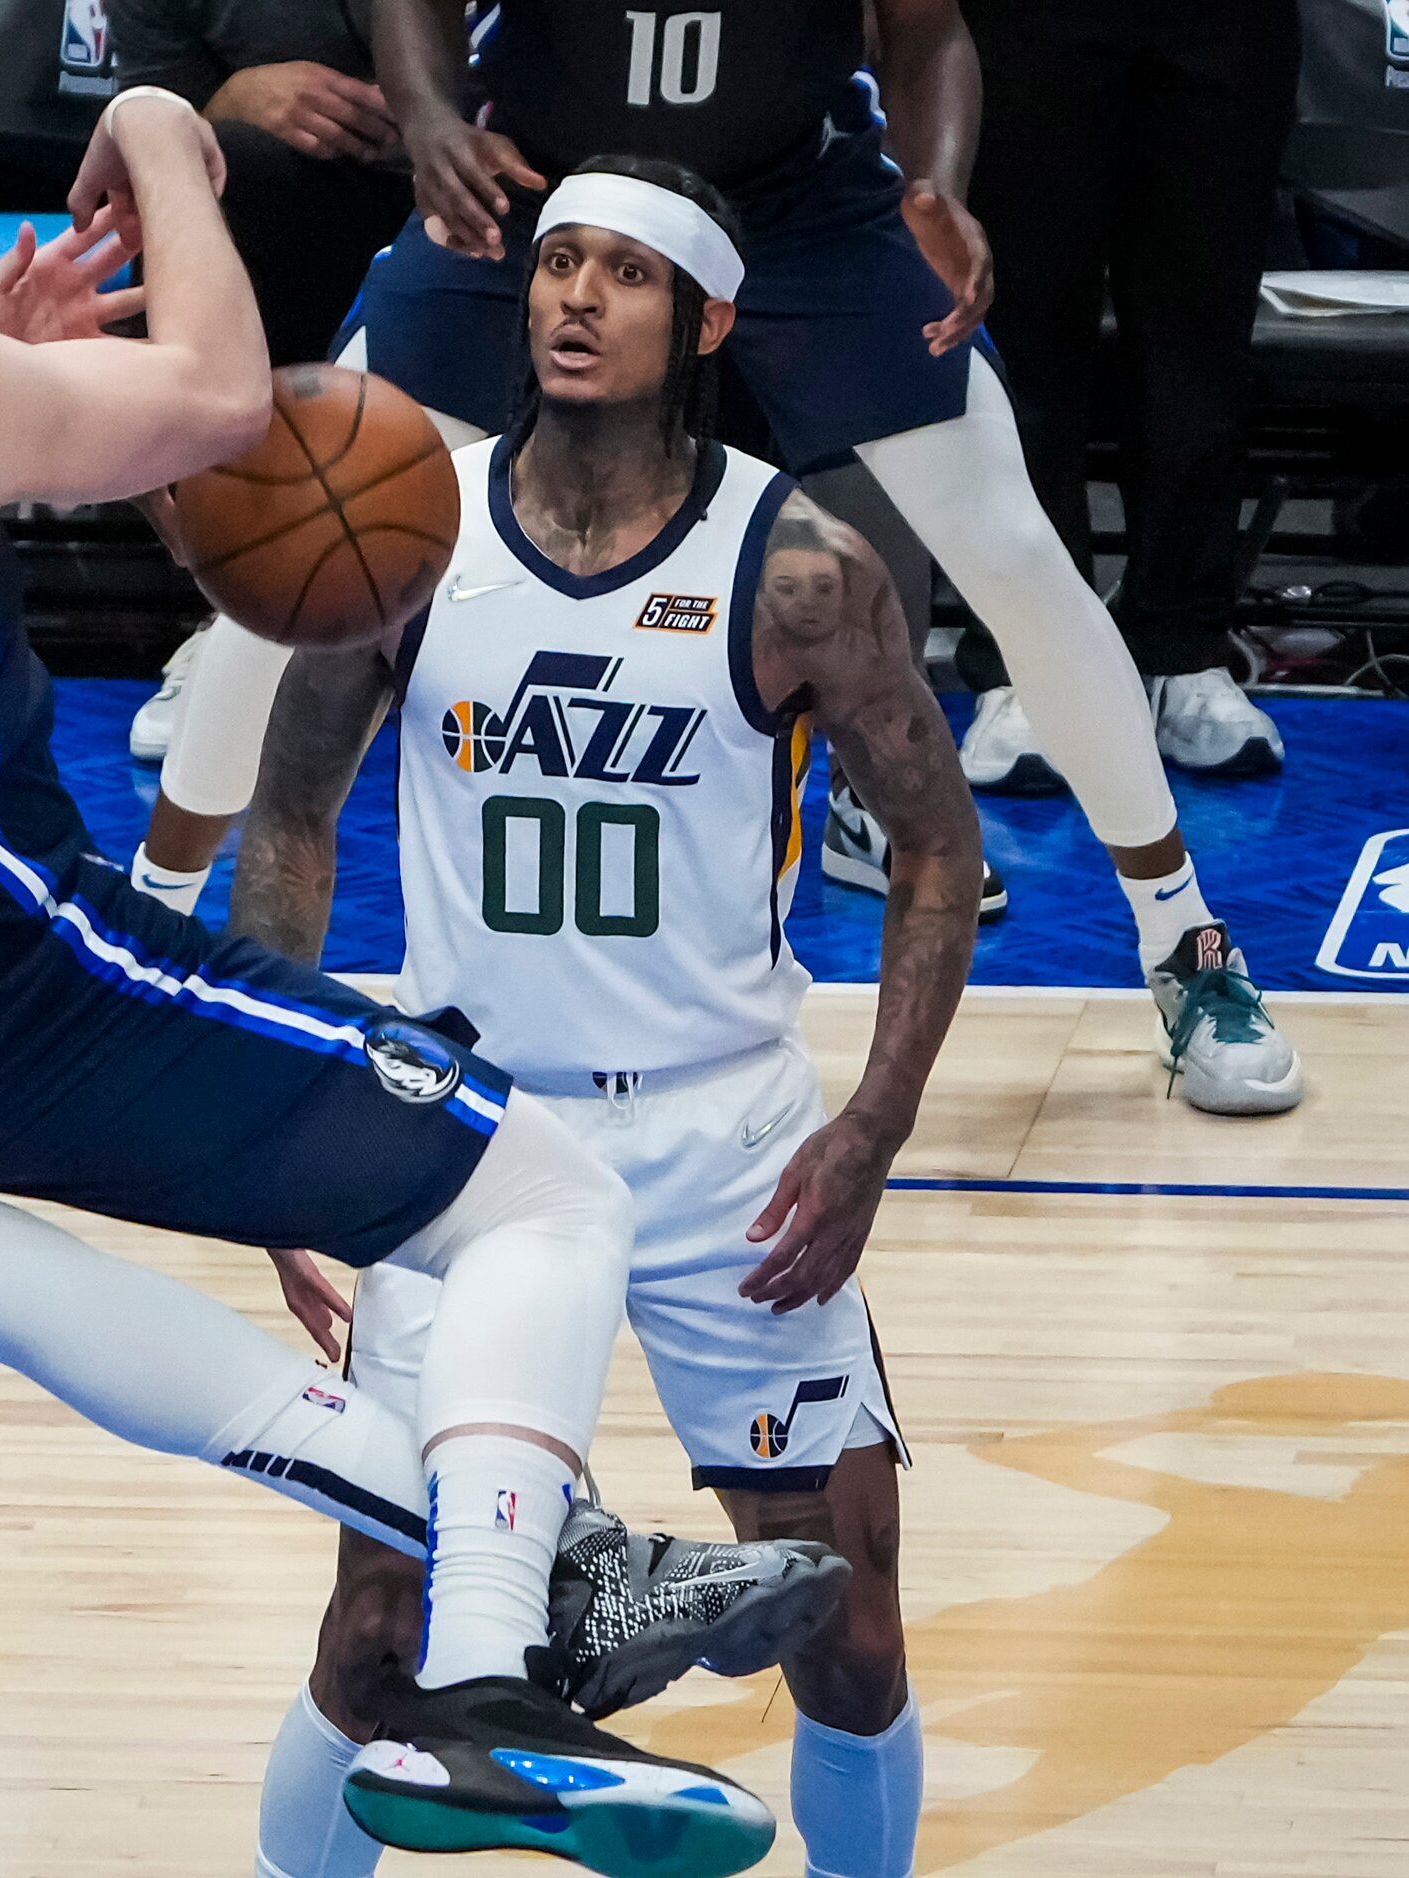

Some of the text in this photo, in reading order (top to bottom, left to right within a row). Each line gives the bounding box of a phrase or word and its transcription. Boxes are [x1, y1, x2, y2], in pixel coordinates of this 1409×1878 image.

[626, 10, 721, 104] 10
[642, 597, 668, 626] 5
[674, 598, 709, 610] FOR THE
[663, 613, 711, 630] FIGHT
[482, 795, 660, 938] 00
